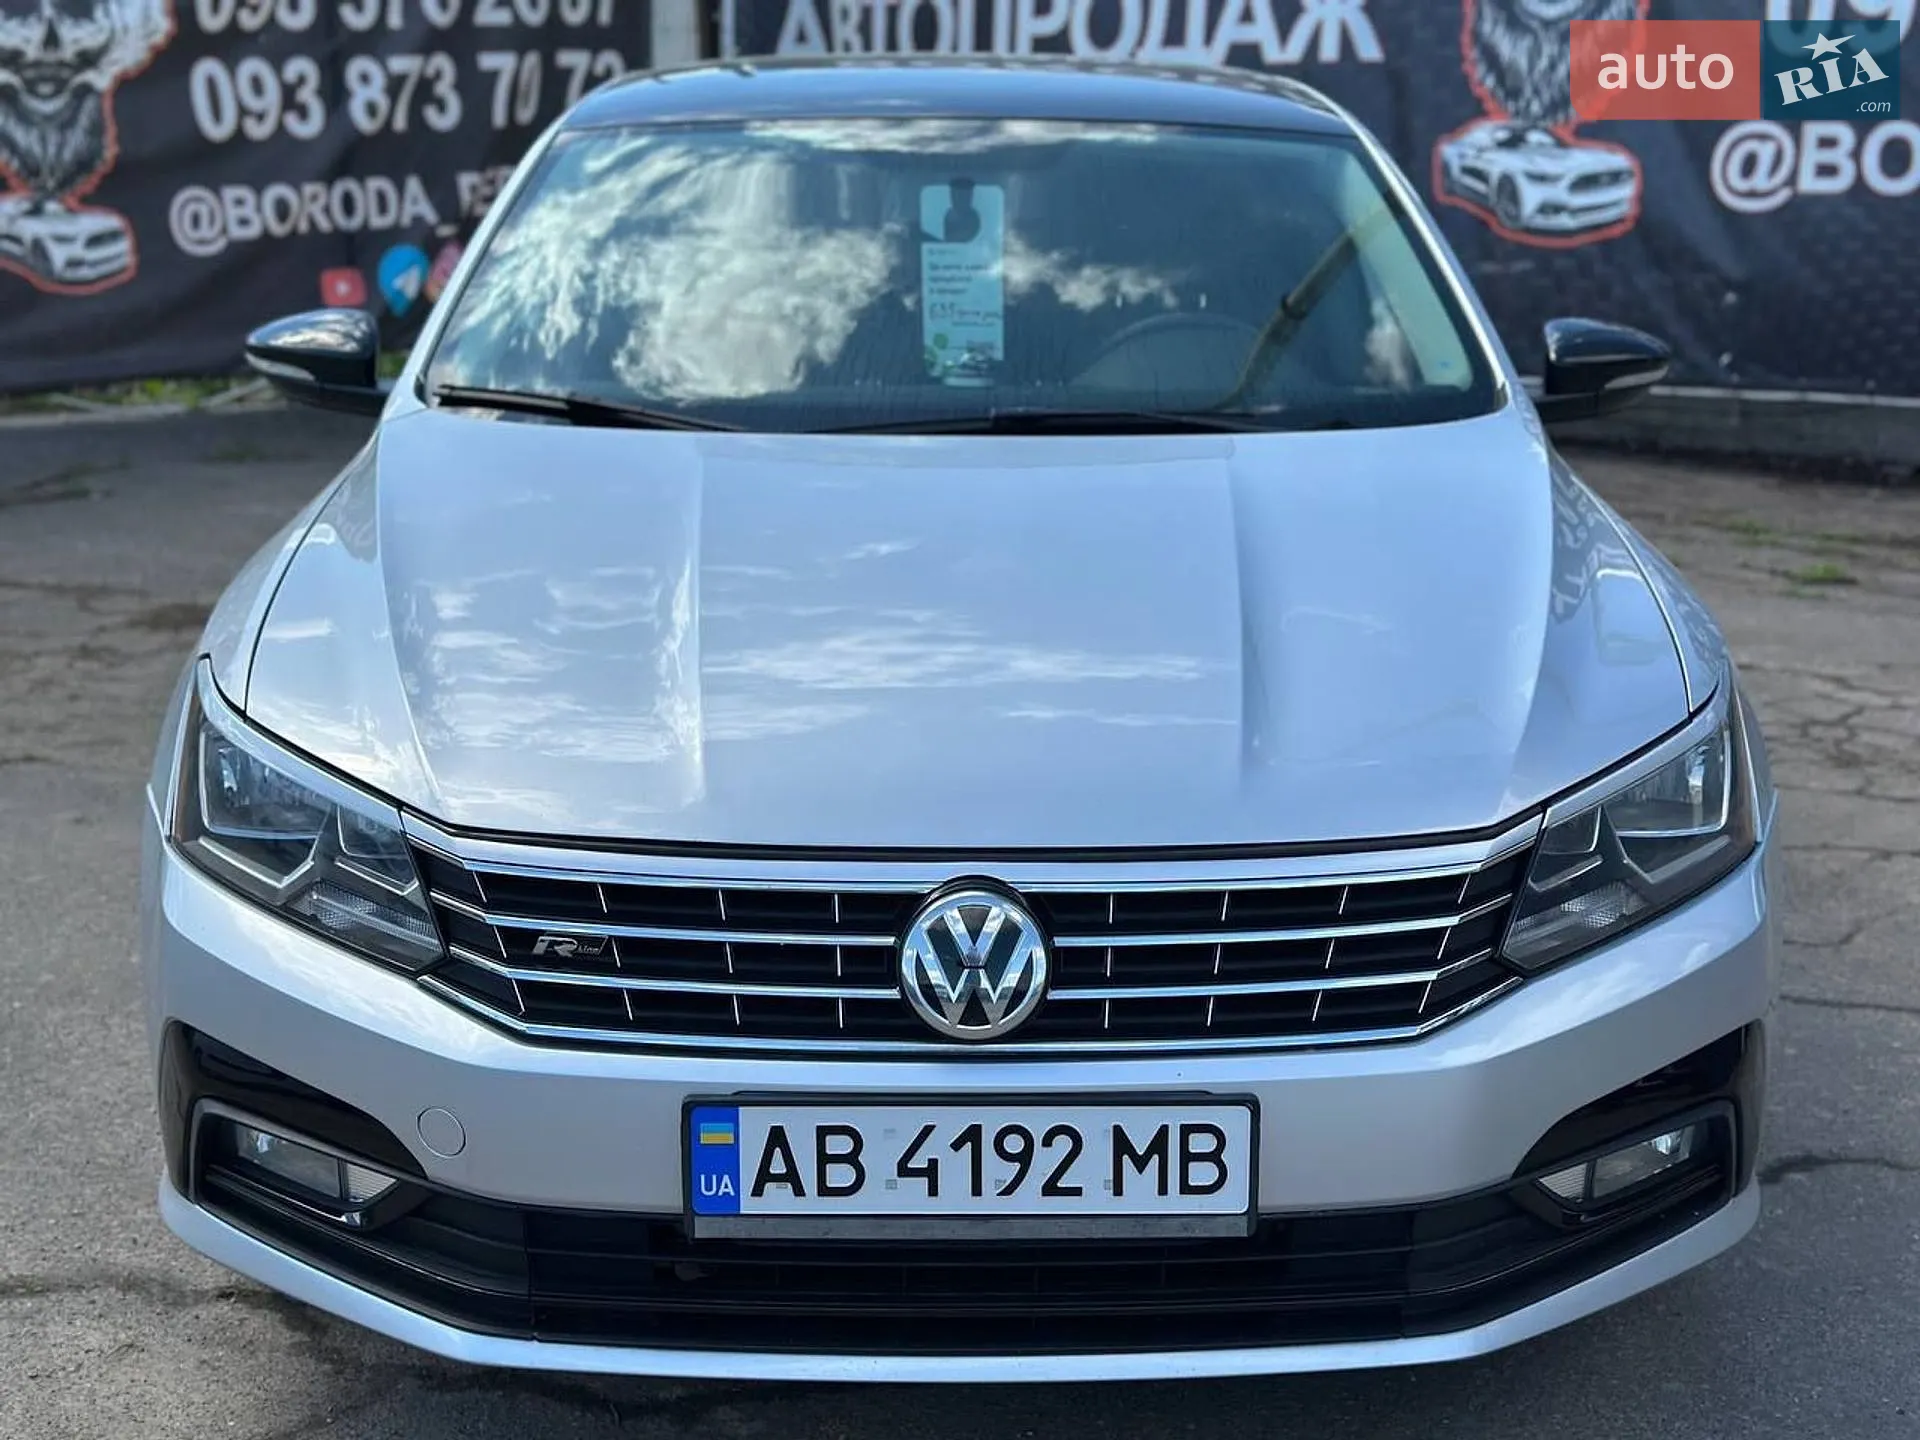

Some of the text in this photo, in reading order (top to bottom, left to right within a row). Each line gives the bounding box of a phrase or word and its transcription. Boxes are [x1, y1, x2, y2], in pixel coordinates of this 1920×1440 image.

[189, 56, 326, 142] 093
[344, 50, 462, 135] 873
[1710, 120, 1920, 213] @BO
[700, 1124, 1228, 1197] UA AB 4192 MB
